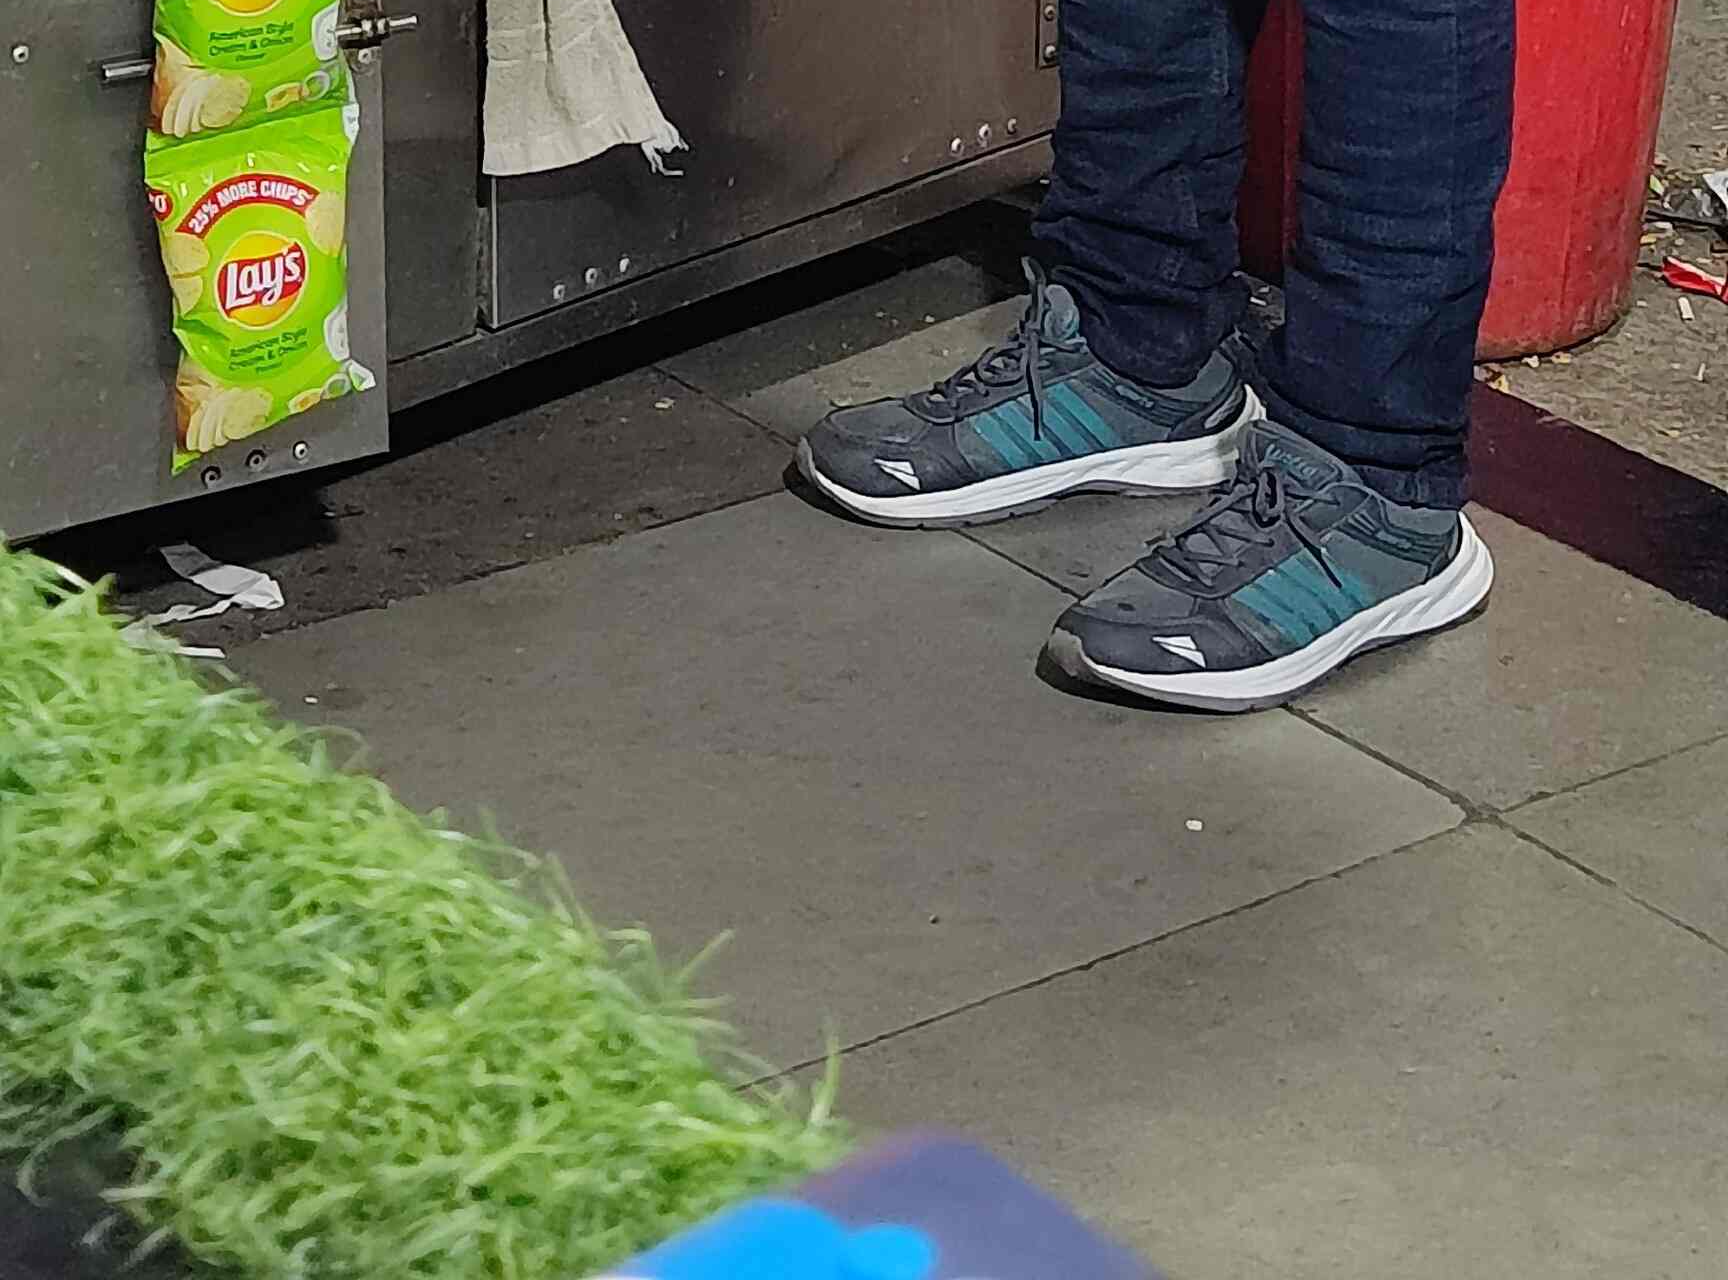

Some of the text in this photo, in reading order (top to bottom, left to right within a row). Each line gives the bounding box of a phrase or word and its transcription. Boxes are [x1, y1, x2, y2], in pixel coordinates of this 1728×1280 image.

[188, 200, 219, 233] 25%
[216, 180, 257, 207] MORE
[225, 248, 301, 310] Lay's
